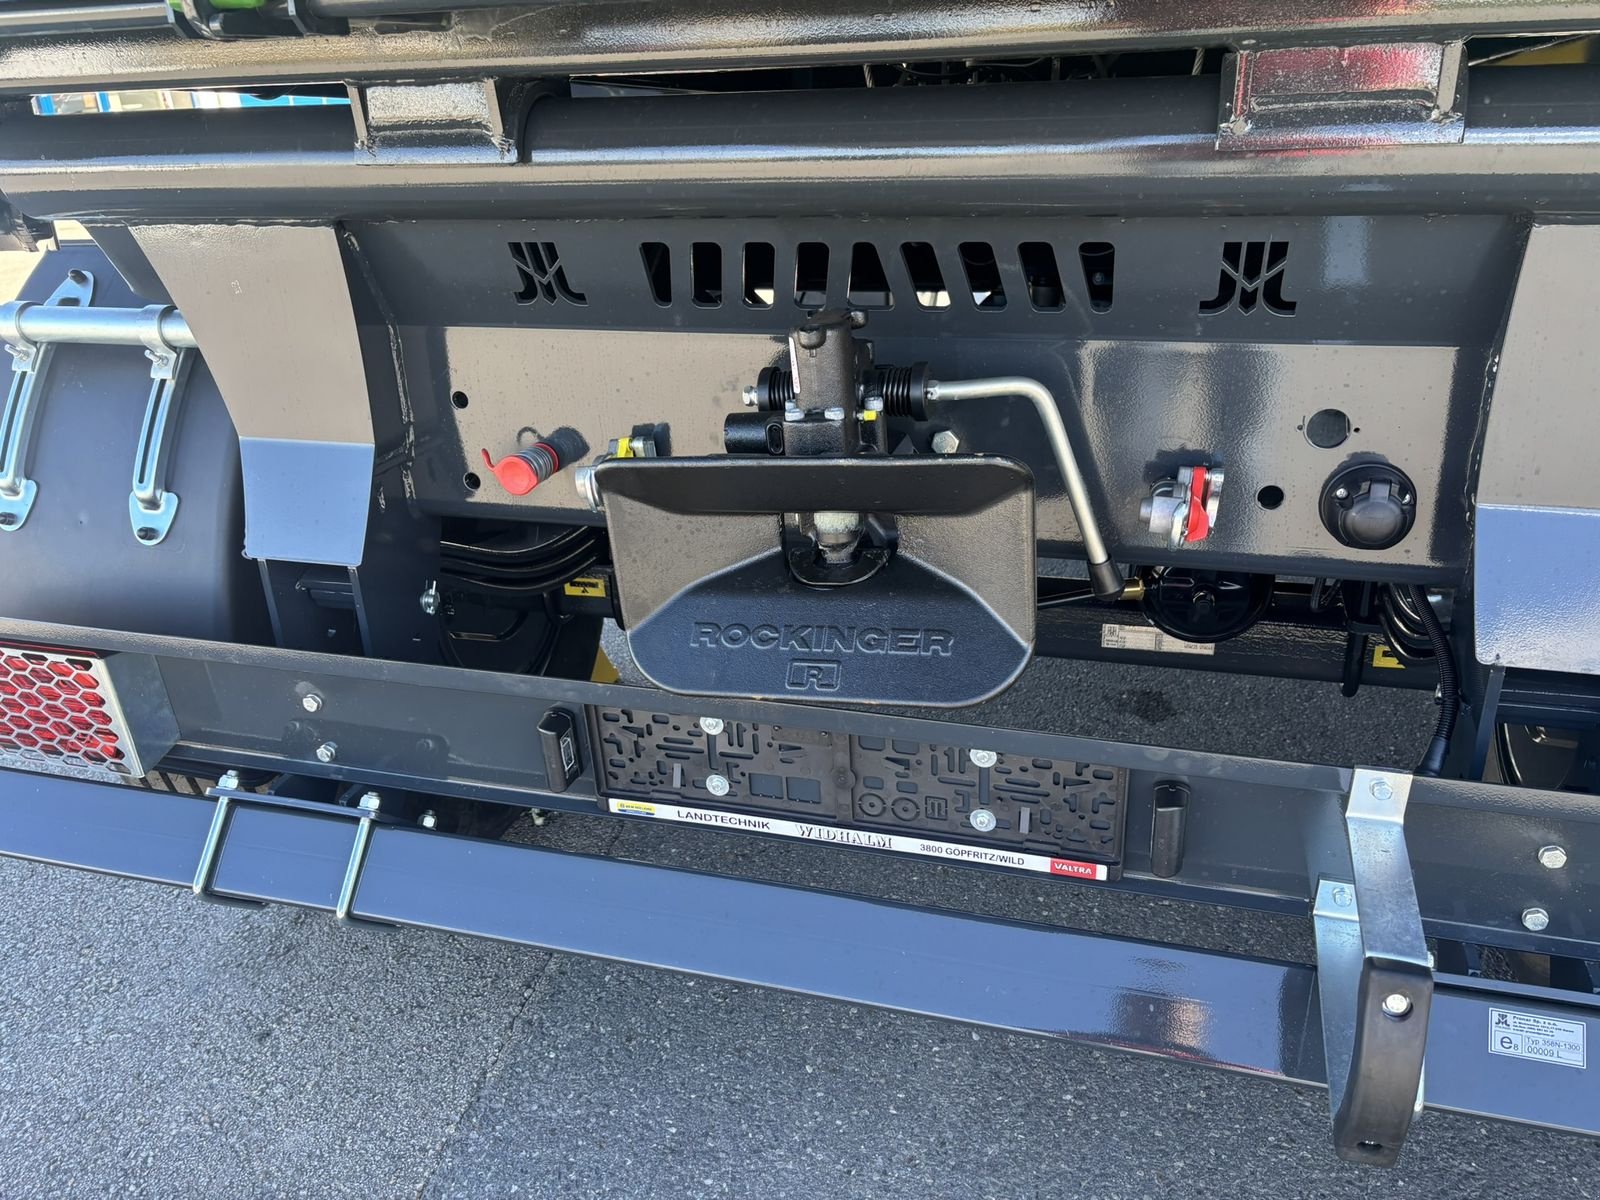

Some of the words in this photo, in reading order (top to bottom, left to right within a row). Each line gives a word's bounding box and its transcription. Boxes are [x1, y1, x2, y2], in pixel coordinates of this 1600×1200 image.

[690, 622, 954, 656] ROCKINGER
[677, 810, 771, 830] LANDTECHNIK
[795, 824, 893, 849] WIDHALM
[919, 843, 943, 855] 3800
[1054, 862, 1093, 876] VALTRA
[1527, 1046, 1554, 1058] 00009
